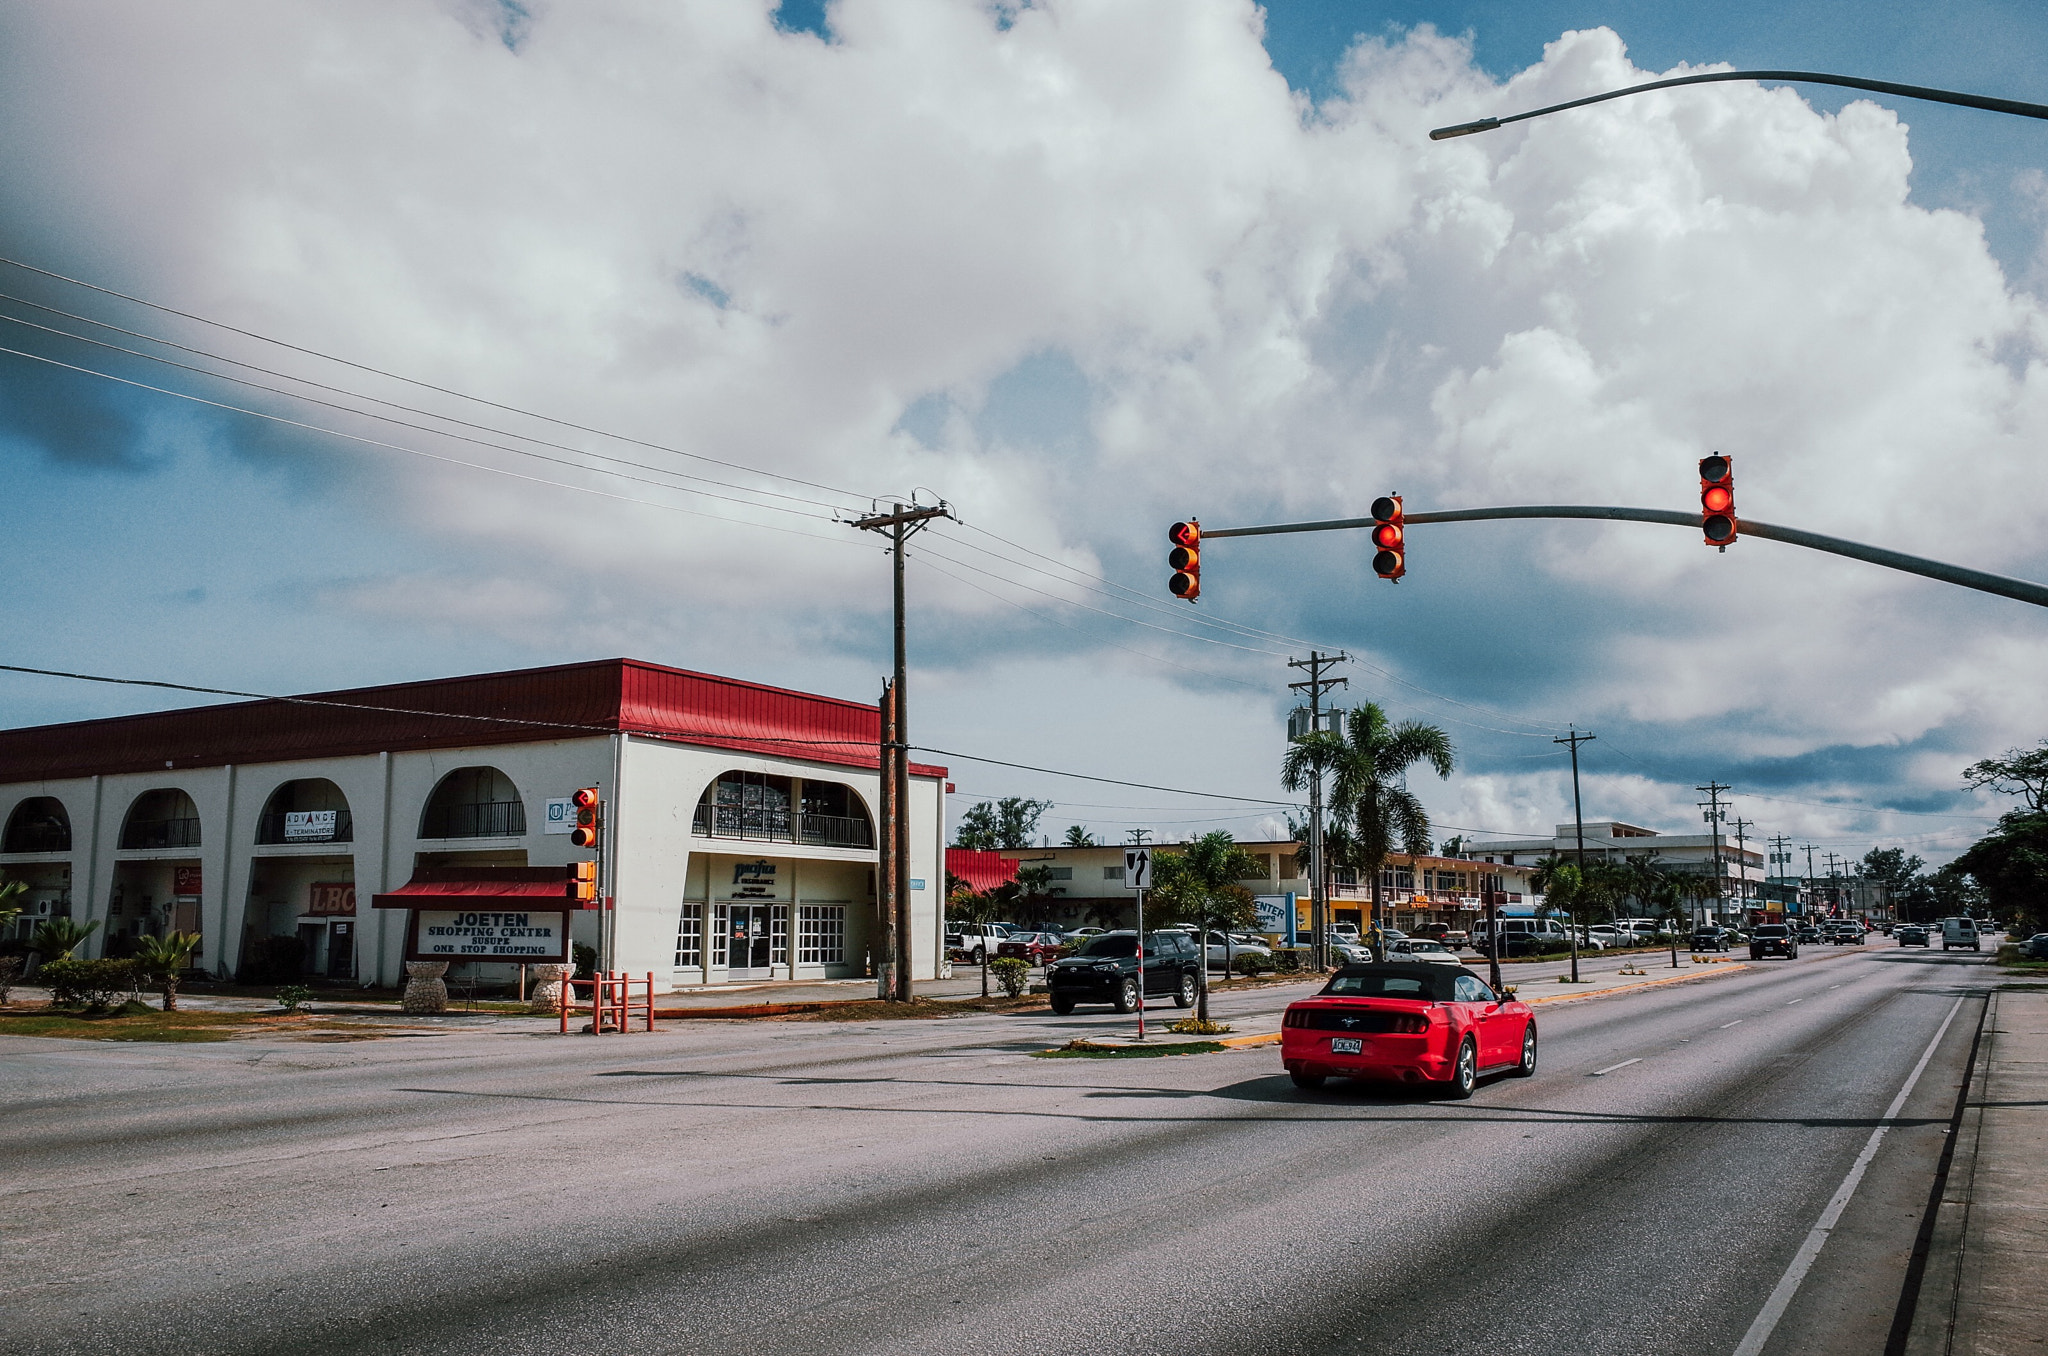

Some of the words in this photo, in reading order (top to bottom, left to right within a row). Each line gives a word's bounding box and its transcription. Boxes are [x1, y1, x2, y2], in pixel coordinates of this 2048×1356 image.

[287, 812, 335, 827] ADVANCE
[313, 888, 356, 911] LBC
[1254, 901, 1285, 919] ENTER
[454, 913, 528, 927] JOETEN
[429, 927, 494, 937] SHOPPING
[501, 928, 552, 937] CENTER
[472, 937, 510, 945] SUSUPE
[461, 945, 487, 953] STOP
[493, 946, 546, 954] SHOPPING
